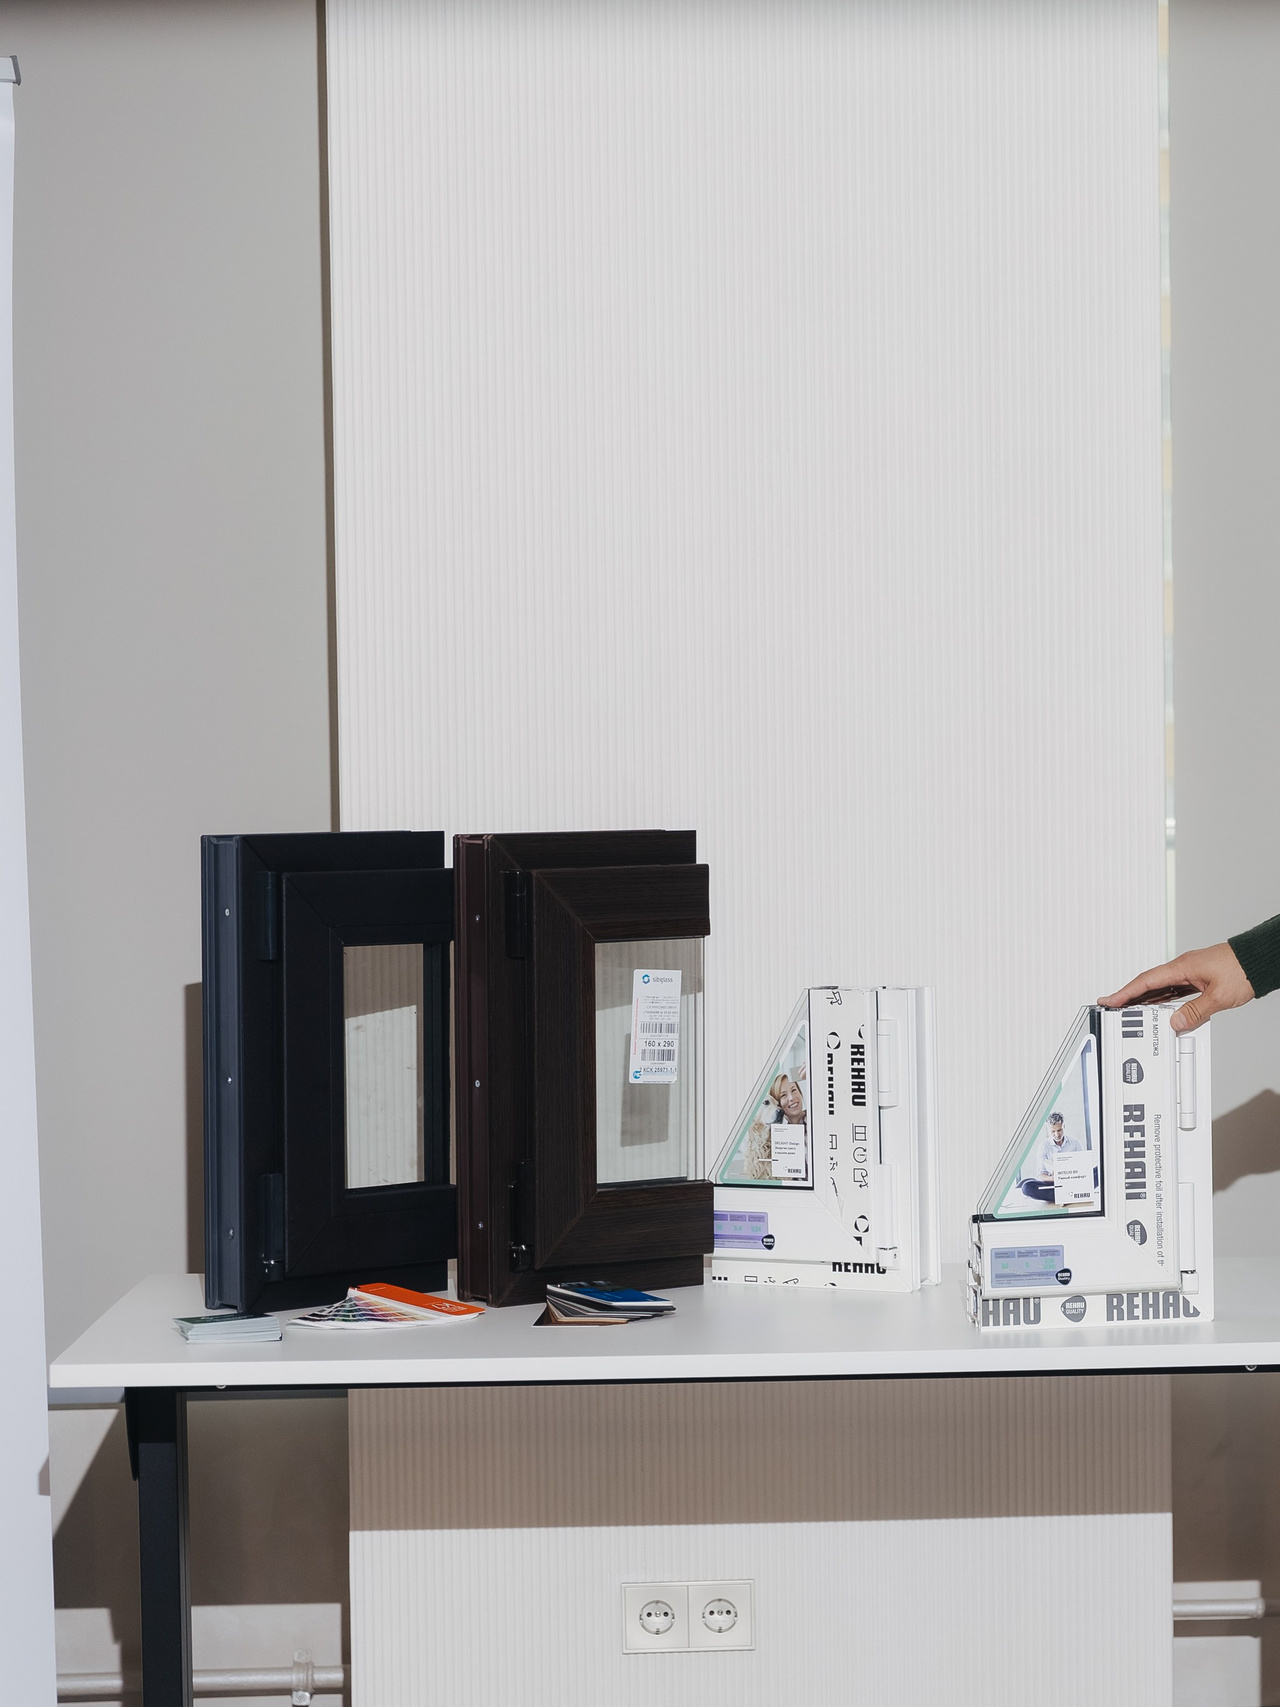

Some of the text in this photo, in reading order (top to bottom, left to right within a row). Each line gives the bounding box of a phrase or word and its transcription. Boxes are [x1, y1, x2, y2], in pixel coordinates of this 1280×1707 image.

[652, 976, 674, 984] sibglass
[1153, 1114, 1162, 1143] Remove
[1153, 1144, 1163, 1179] protective
[1155, 1180, 1164, 1192] foil
[1155, 1193, 1164, 1210] after
[1156, 1211, 1165, 1249] installation
[1065, 1301, 1085, 1309] REHAU
